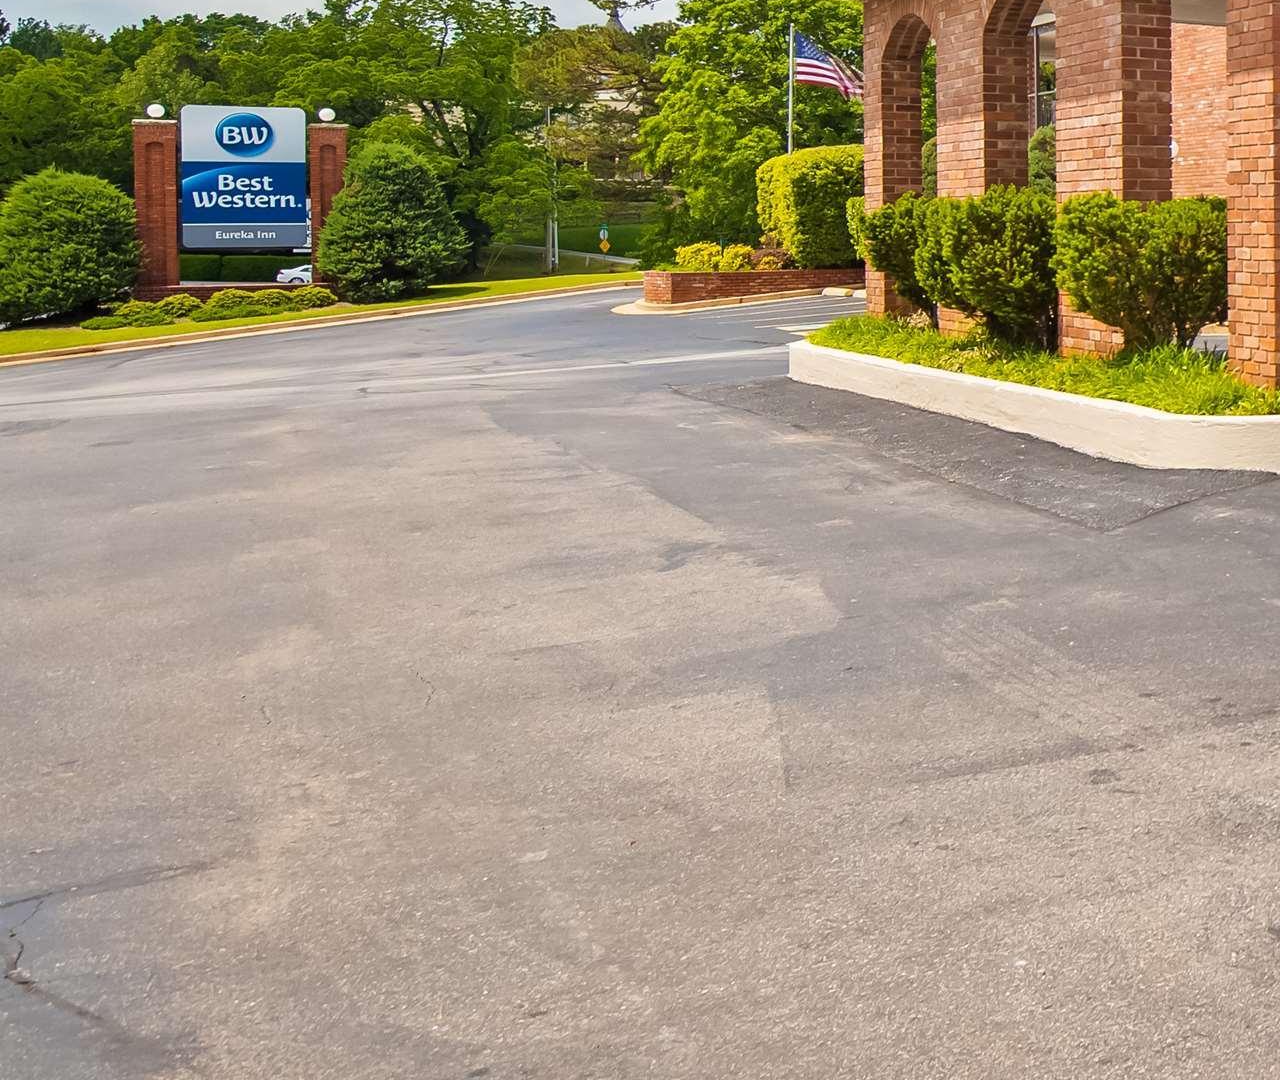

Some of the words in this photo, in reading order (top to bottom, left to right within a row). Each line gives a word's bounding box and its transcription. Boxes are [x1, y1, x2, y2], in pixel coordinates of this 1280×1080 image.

[222, 126, 268, 145] BW
[218, 174, 273, 191] Best
[215, 230, 254, 239] Eureka
[257, 230, 276, 239] Inn
